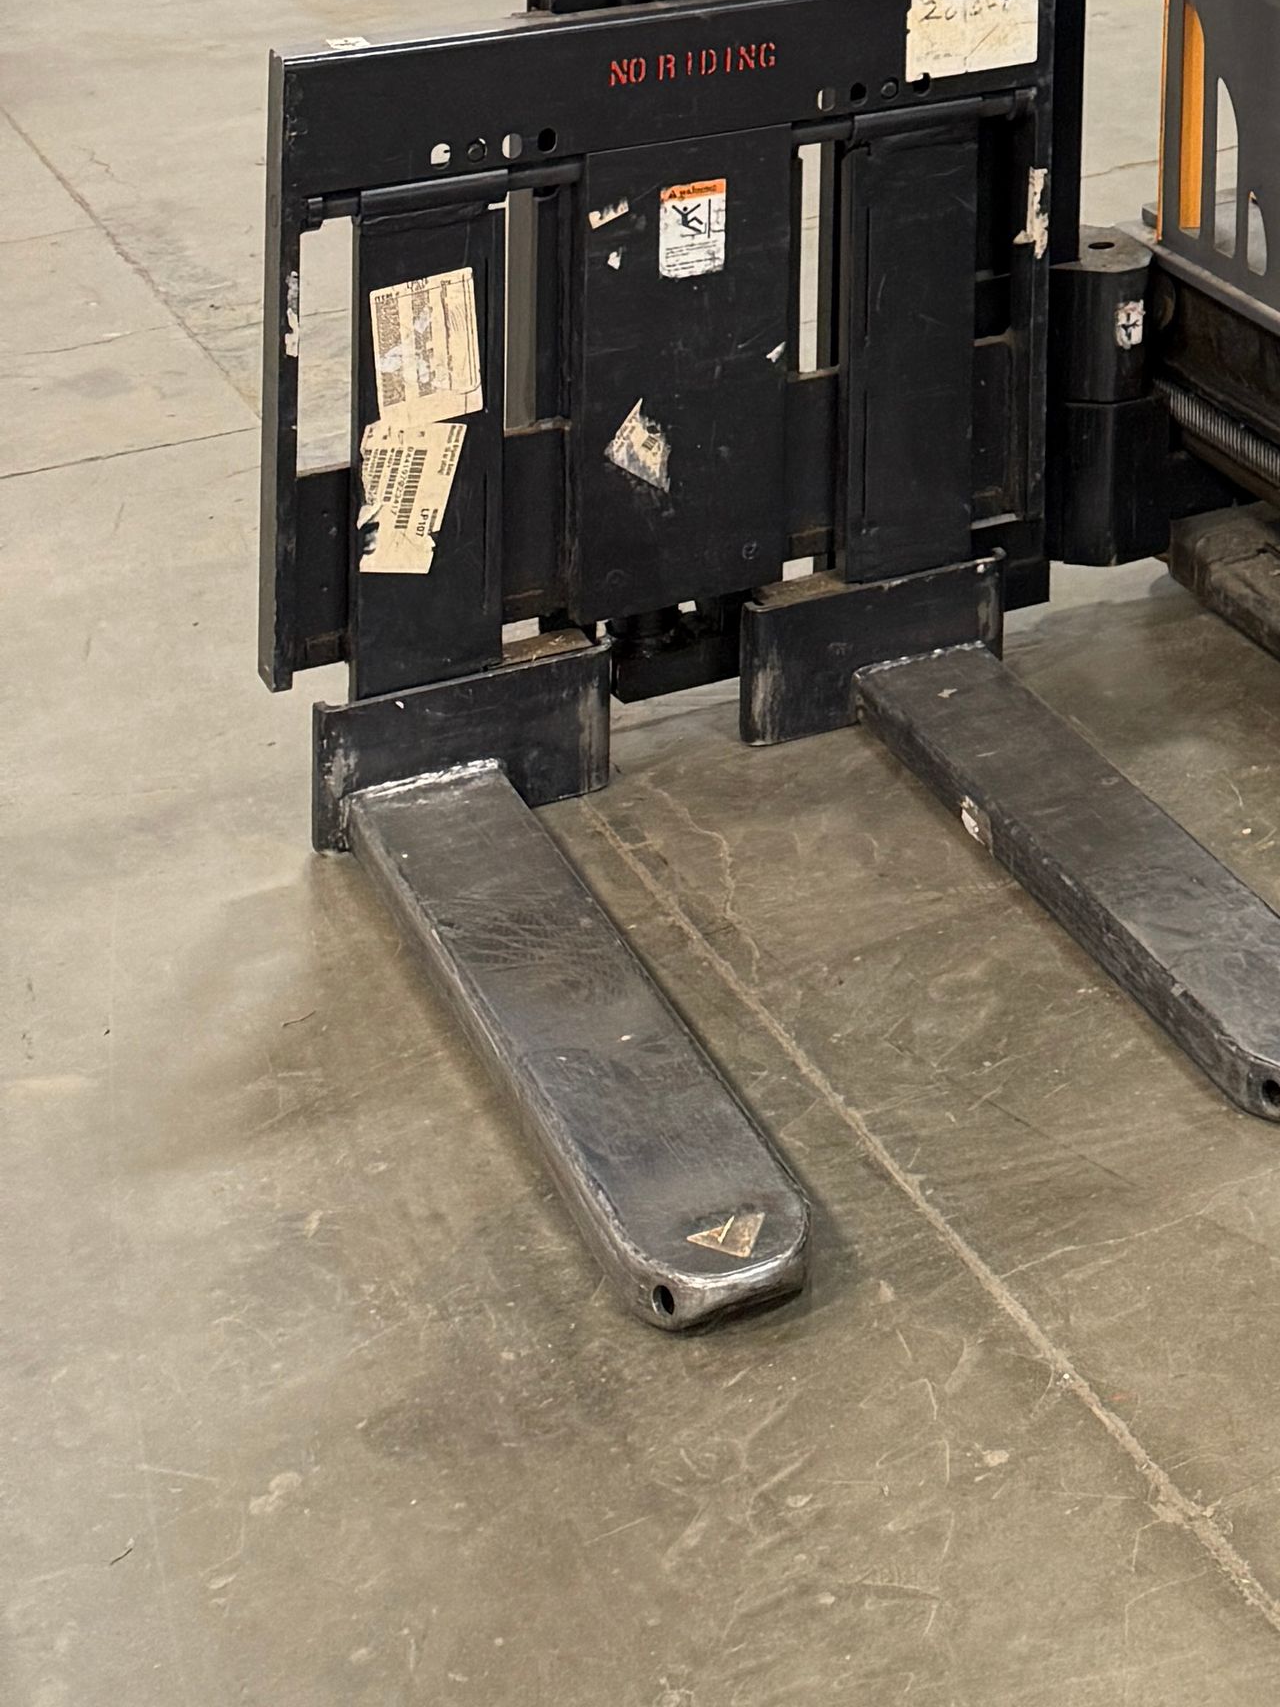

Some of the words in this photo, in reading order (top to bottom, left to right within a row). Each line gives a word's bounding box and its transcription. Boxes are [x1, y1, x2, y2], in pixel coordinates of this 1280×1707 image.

[610, 57, 647, 87] NO
[658, 42, 776, 81] RIDING
[415, 508, 430, 537] LP107
